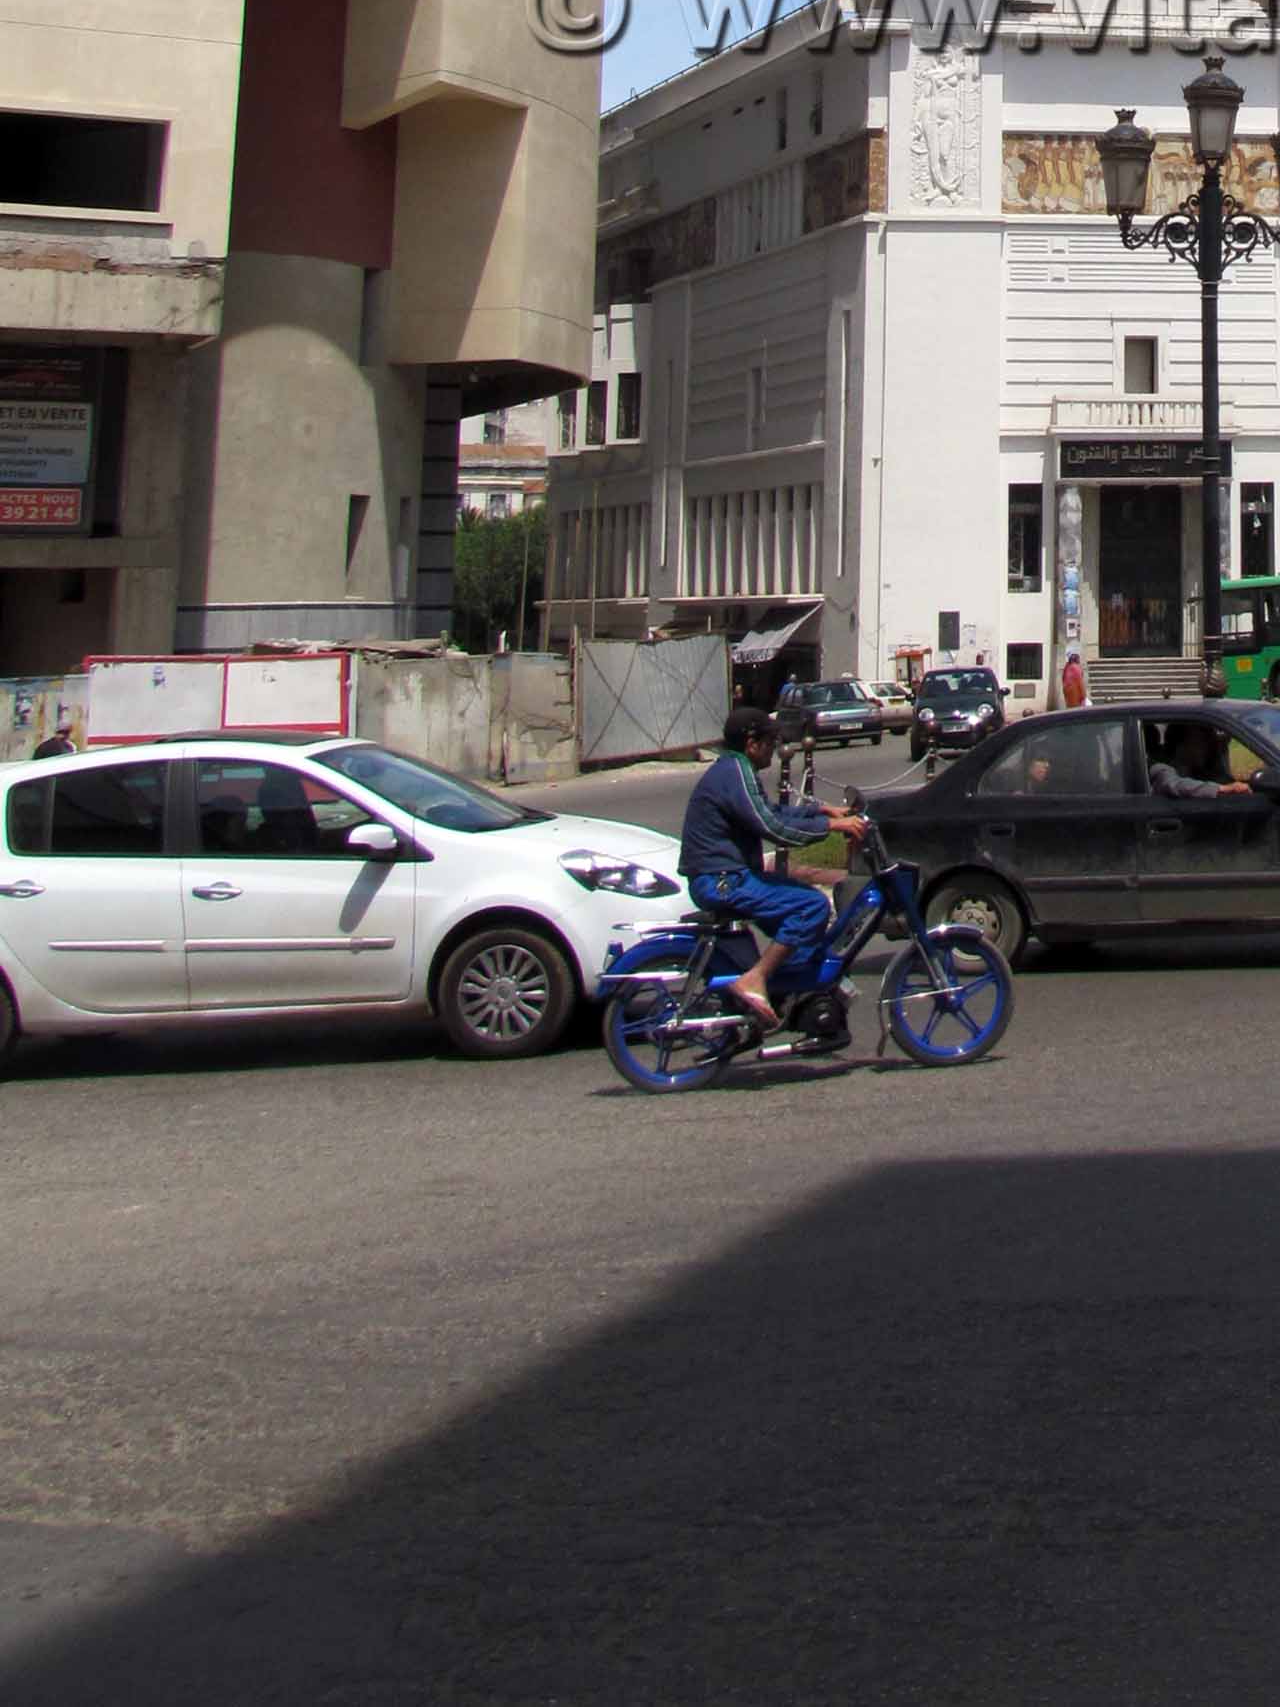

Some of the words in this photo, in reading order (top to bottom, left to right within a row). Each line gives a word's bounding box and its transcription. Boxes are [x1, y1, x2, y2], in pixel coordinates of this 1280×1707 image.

[18, 407, 37, 420] EN
[40, 407, 88, 421] VENTE
[42, 494, 76, 504] NOUS
[2, 506, 25, 520] 39
[27, 506, 49, 520] 21
[53, 506, 75, 520] 44
